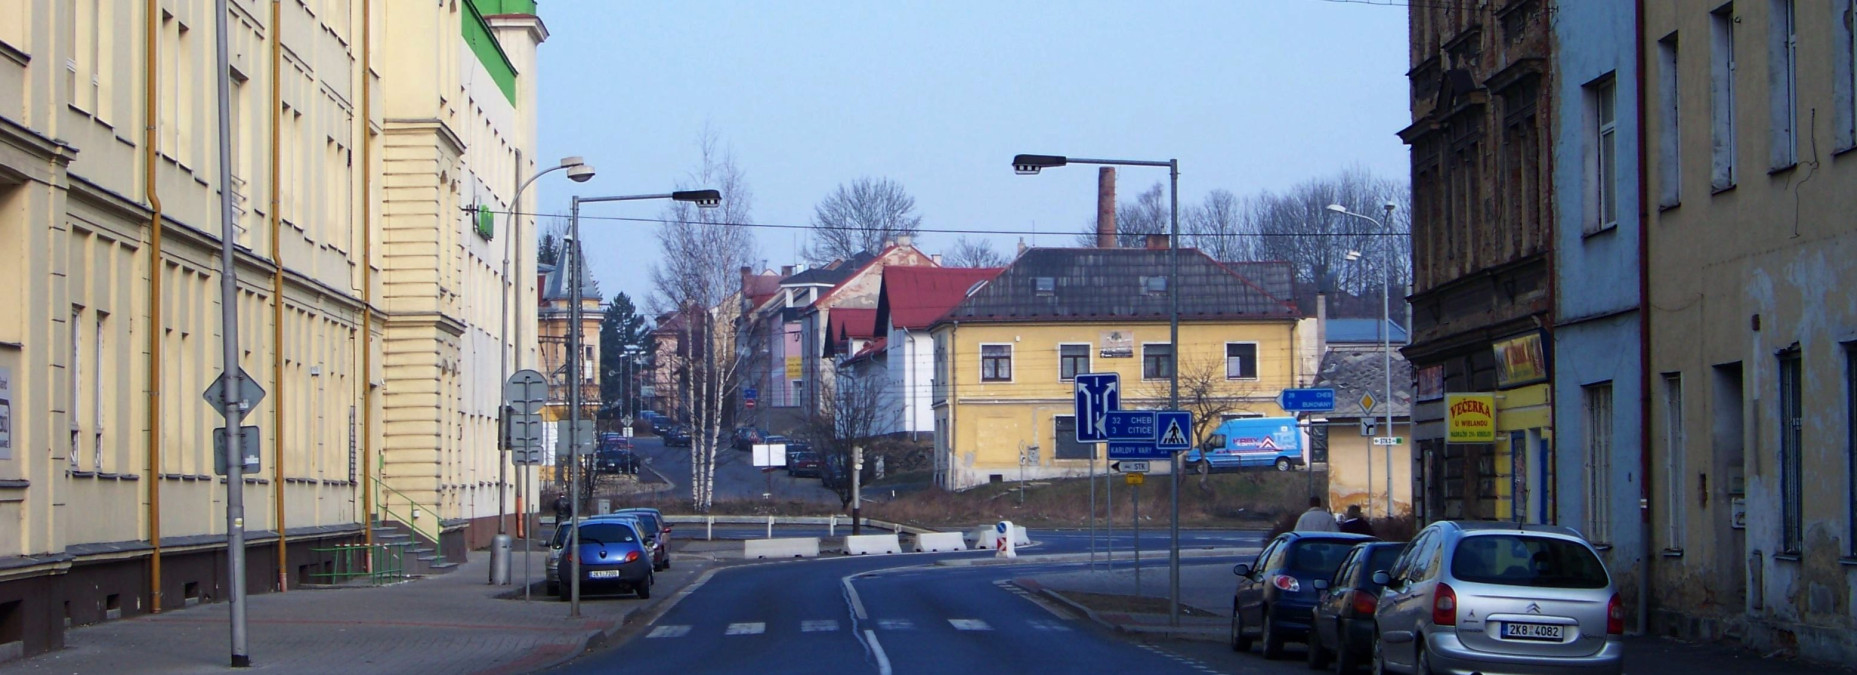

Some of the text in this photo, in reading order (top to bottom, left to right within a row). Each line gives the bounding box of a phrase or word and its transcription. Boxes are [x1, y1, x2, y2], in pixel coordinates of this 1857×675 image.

[1450, 398, 1491, 418] VEČERKA
[1510, 624, 1559, 637] 2K8 4082
